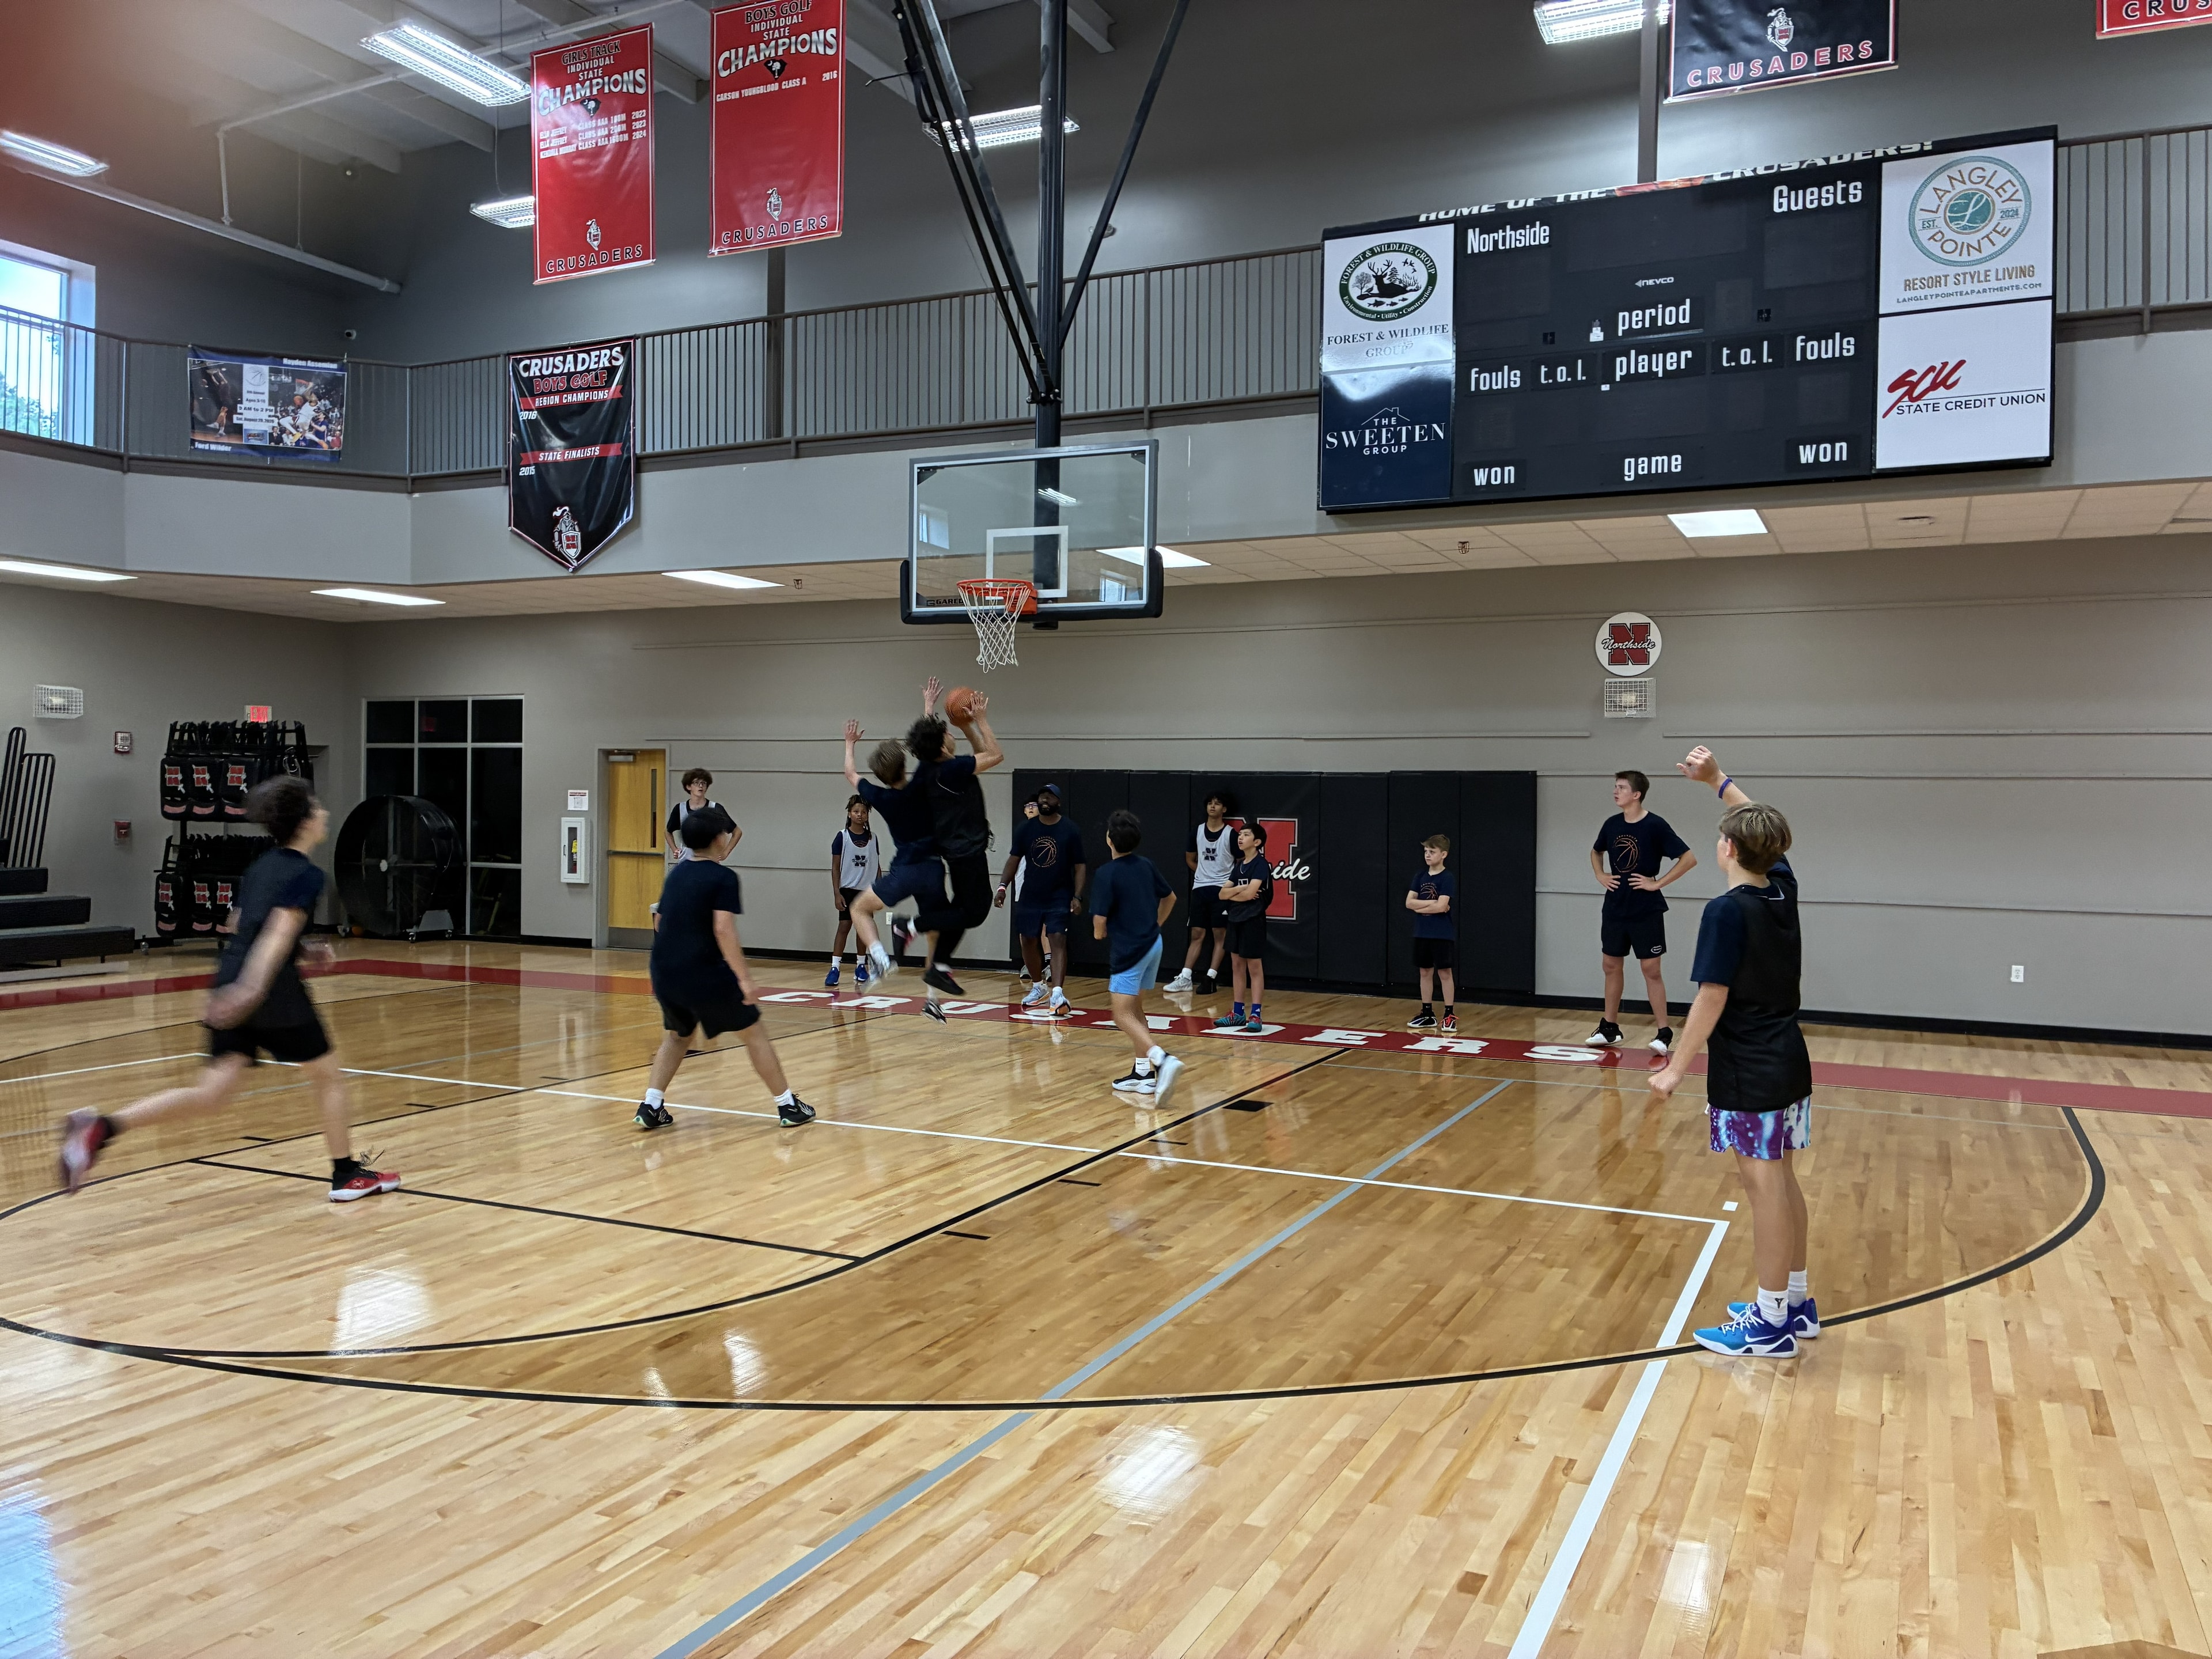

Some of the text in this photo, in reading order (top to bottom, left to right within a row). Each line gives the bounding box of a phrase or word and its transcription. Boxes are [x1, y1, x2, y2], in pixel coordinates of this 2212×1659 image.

[745, 0, 812, 24] BOYS GOLF
[751, 14, 803, 33] INDIVIDUAL
[763, 27, 790, 40] STATE
[562, 40, 620, 65] GIRLS TRACK
[567, 55, 615, 73] INDIVIDUAL
[718, 28, 837, 77] CHAMPIONS
[1687, 40, 1872, 87] CRUSADERS
[579, 68, 603, 81] STATE
[538, 69, 647, 116] CHAMPIONS
[717, 90, 740, 102] CARSON
[782, 79, 800, 89] CLASS
[578, 130, 596, 140] CLASS
[578, 140, 596, 150] CLASS
[1772, 179, 1863, 214] Guests
[1920, 166, 2022, 214] LANGLEY
[722, 215, 828, 244] CRUSADERS
[1922, 209, 2018, 229] EST. 2024
[1467, 222, 1550, 255] Northside
[1927, 222, 2012, 257] POINTE
[546, 244, 642, 273] CRUSADERS
[1341, 253, 1365, 284] FOREST
[1373, 243, 1415, 255] WILDLIFE
[1415, 249, 1435, 274] GROUP
[1904, 264, 2035, 291] RESORT STYLE LIVING
[1343, 296, 1376, 319] Environmental
[1403, 286, 1433, 314] Construction
[1896, 283, 2042, 304] LANGLEYPOINTEAPARTMENTS.COM
[1618, 298, 1691, 336] period
[1327, 324, 1449, 346] FOREST & WILDLIFE
[1796, 332, 1855, 362] fouls
[519, 347, 624, 377] CRUSADERS
[1366, 345, 1407, 358] GROUP
[1615, 349, 1692, 381] player
[533, 370, 607, 394] BOYS GOLF
[1470, 365, 1521, 392] fouls
[535, 390, 608, 407] REGION CHAMPIONS
[1896, 393, 2046, 415] STATE CREDIT UNION
[1373, 417, 1396, 426] THE
[1326, 423, 1445, 449] SWEETEN
[539, 447, 600, 461] STATE FINALISTS
[1363, 445, 1407, 456] GROUP
[1799, 441, 1848, 464] won
[519, 466, 535, 476] 2015
[1473, 464, 1515, 486] won
[1624, 453, 1682, 482] game
[1601, 637, 1656, 650] Northside
[1608, 623, 1650, 665] N
